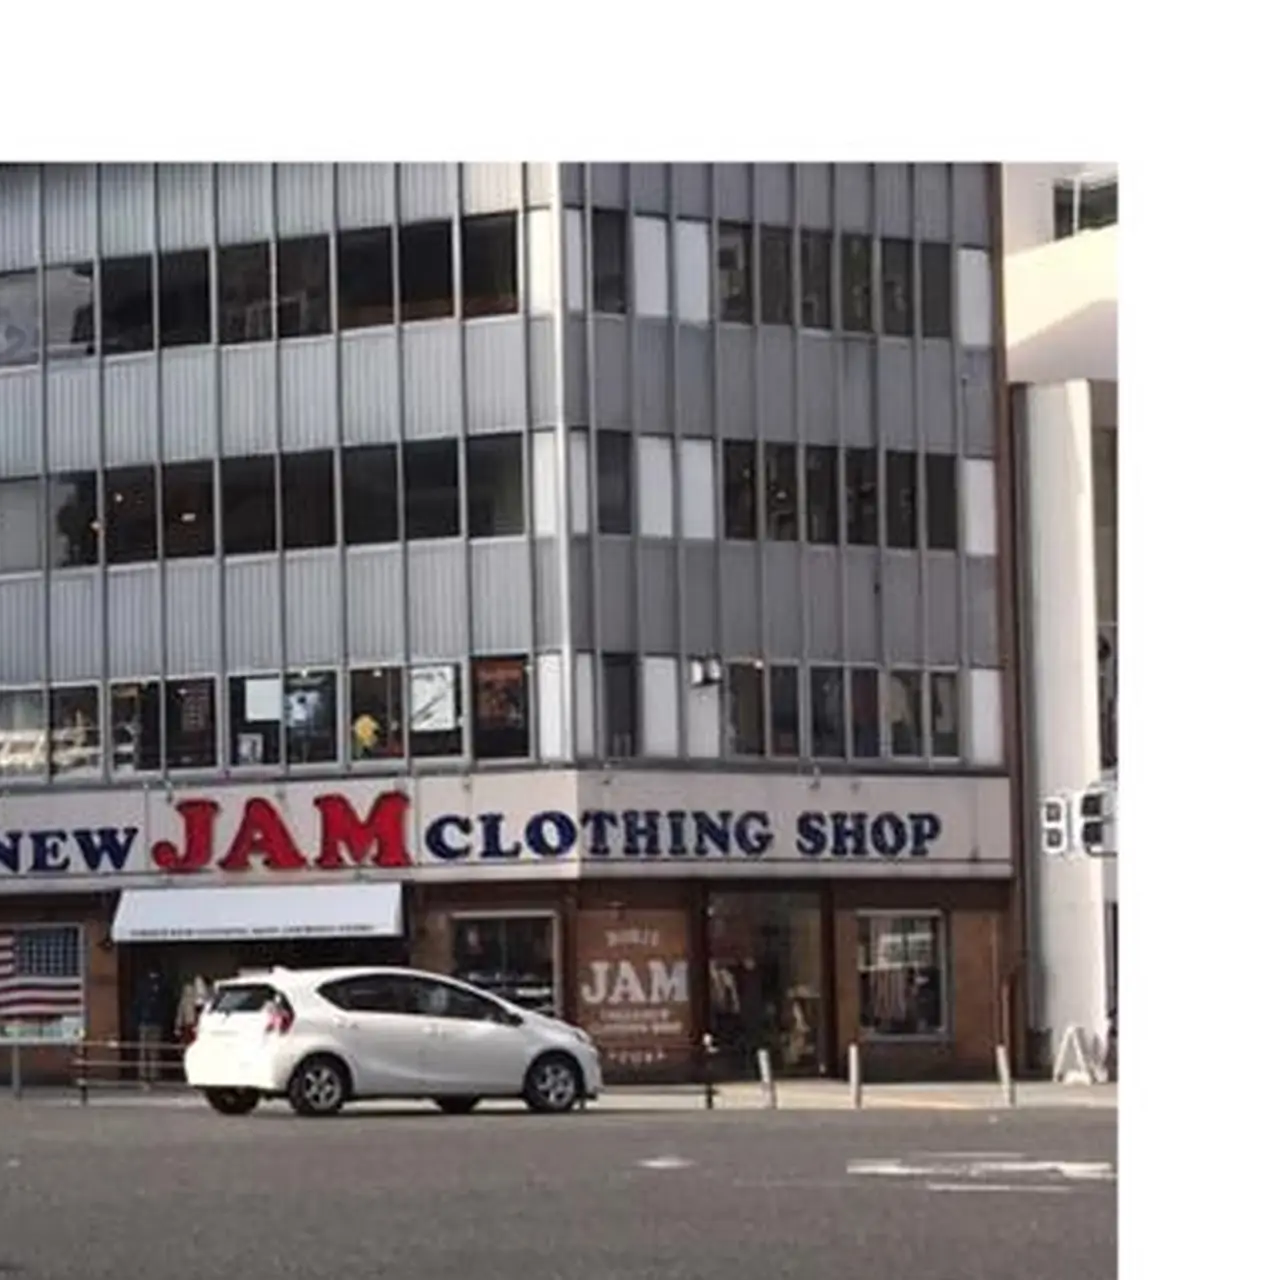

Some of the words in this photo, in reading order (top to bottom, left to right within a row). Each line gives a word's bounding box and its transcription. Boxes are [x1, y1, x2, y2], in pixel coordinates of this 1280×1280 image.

[151, 790, 413, 874] JAM
[425, 809, 774, 859] CLOTHING
[796, 811, 941, 858] SHOP
[580, 959, 690, 1004] JAM
